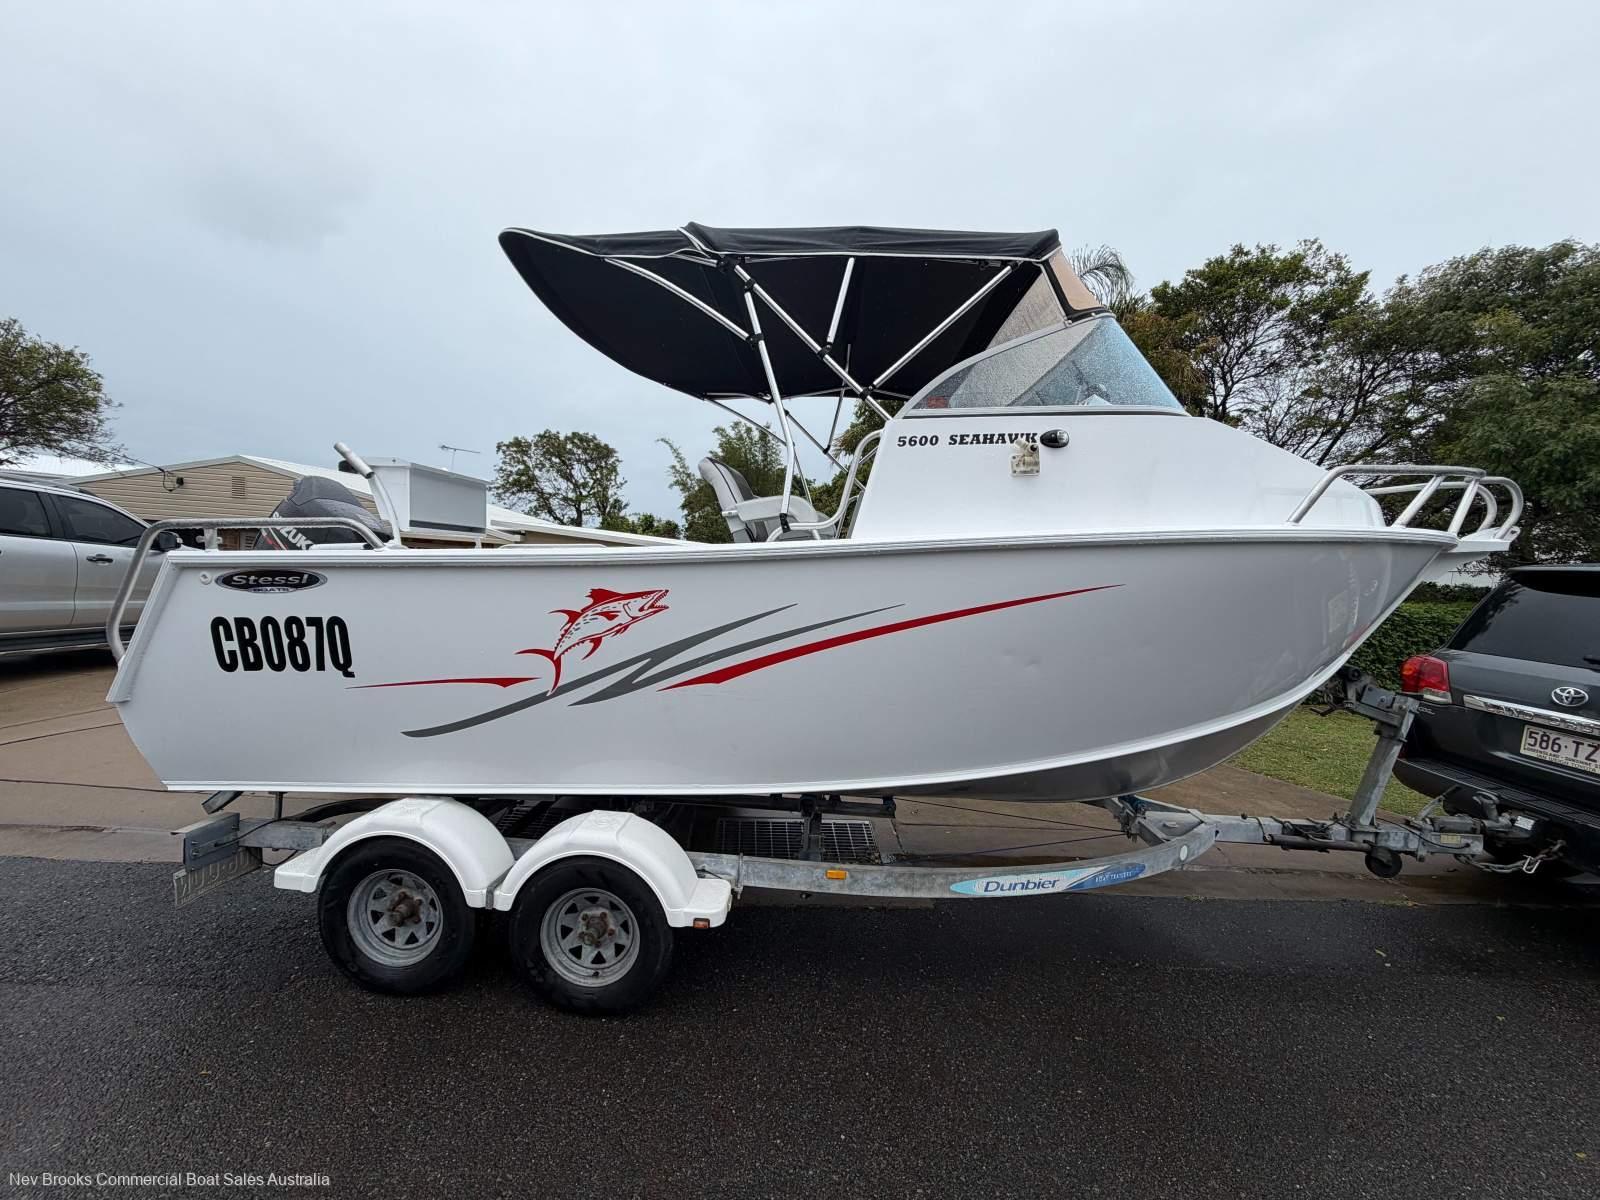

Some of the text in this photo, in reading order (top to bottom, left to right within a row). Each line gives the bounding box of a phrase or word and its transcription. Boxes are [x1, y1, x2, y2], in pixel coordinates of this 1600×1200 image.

[897, 433, 1038, 447] 5600 SEAHAWK
[231, 573, 309, 585] Stessl
[210, 615, 356, 678] CB087Q
[984, 878, 1059, 893] Dunbier
